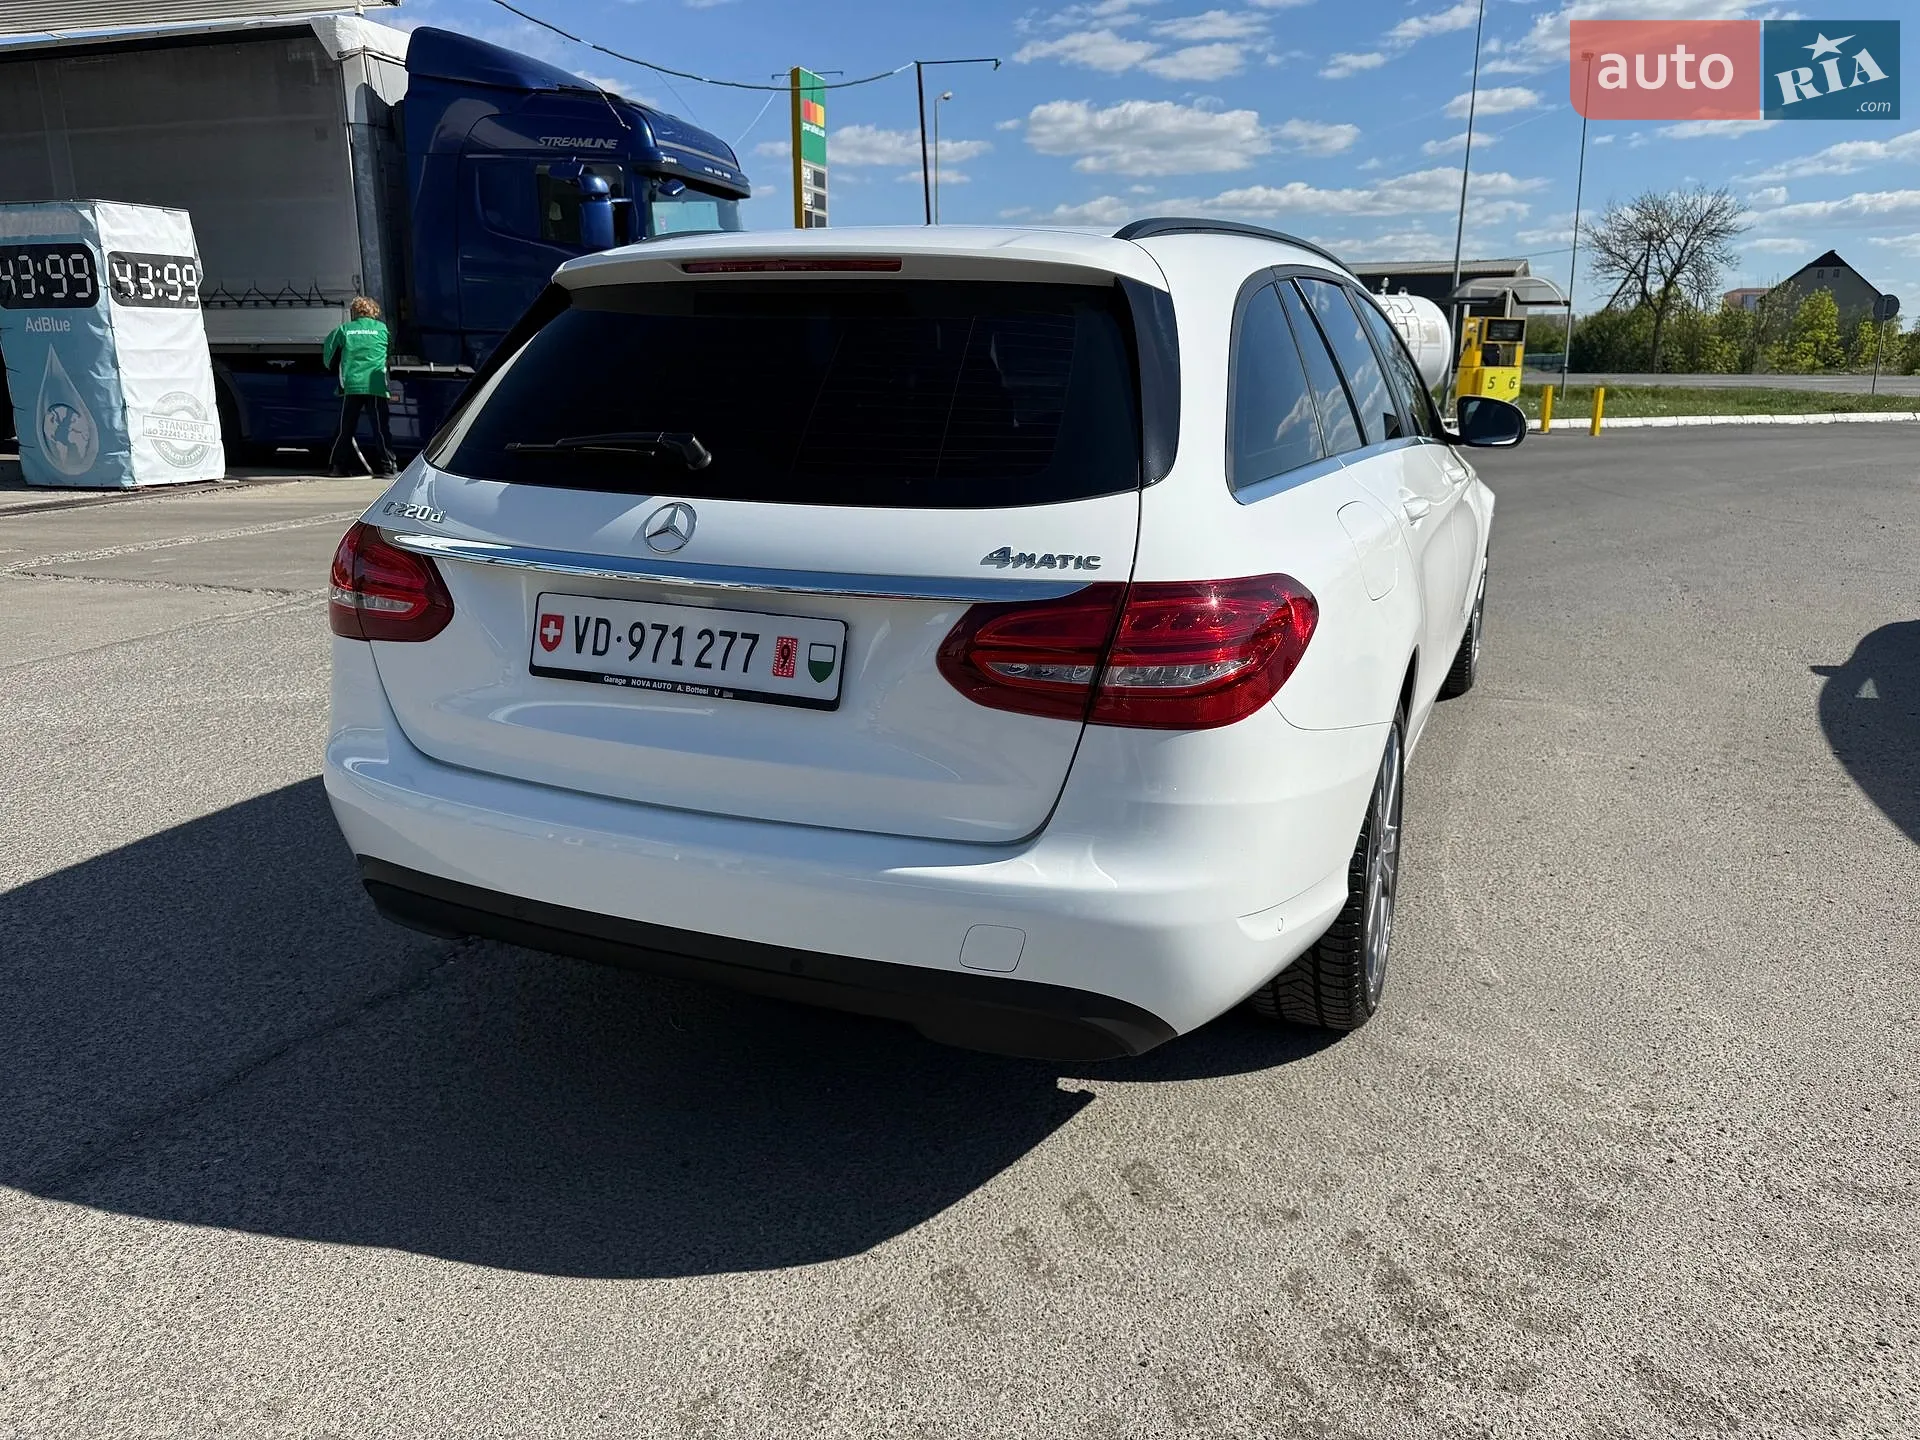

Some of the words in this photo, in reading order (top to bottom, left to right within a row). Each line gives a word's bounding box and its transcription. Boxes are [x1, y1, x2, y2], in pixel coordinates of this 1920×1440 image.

[538, 136, 618, 149] STREAMLINE
[25, 316, 71, 332] AdBlue
[1487, 376, 1496, 390] 5
[1508, 376, 1516, 390] 6
[158, 420, 205, 433] STANDART
[979, 546, 1102, 571] 4MATIC
[603, 675, 627, 686] Garage
[631, 678, 651, 688] NOVA
[652, 681, 672, 690] AUTO
